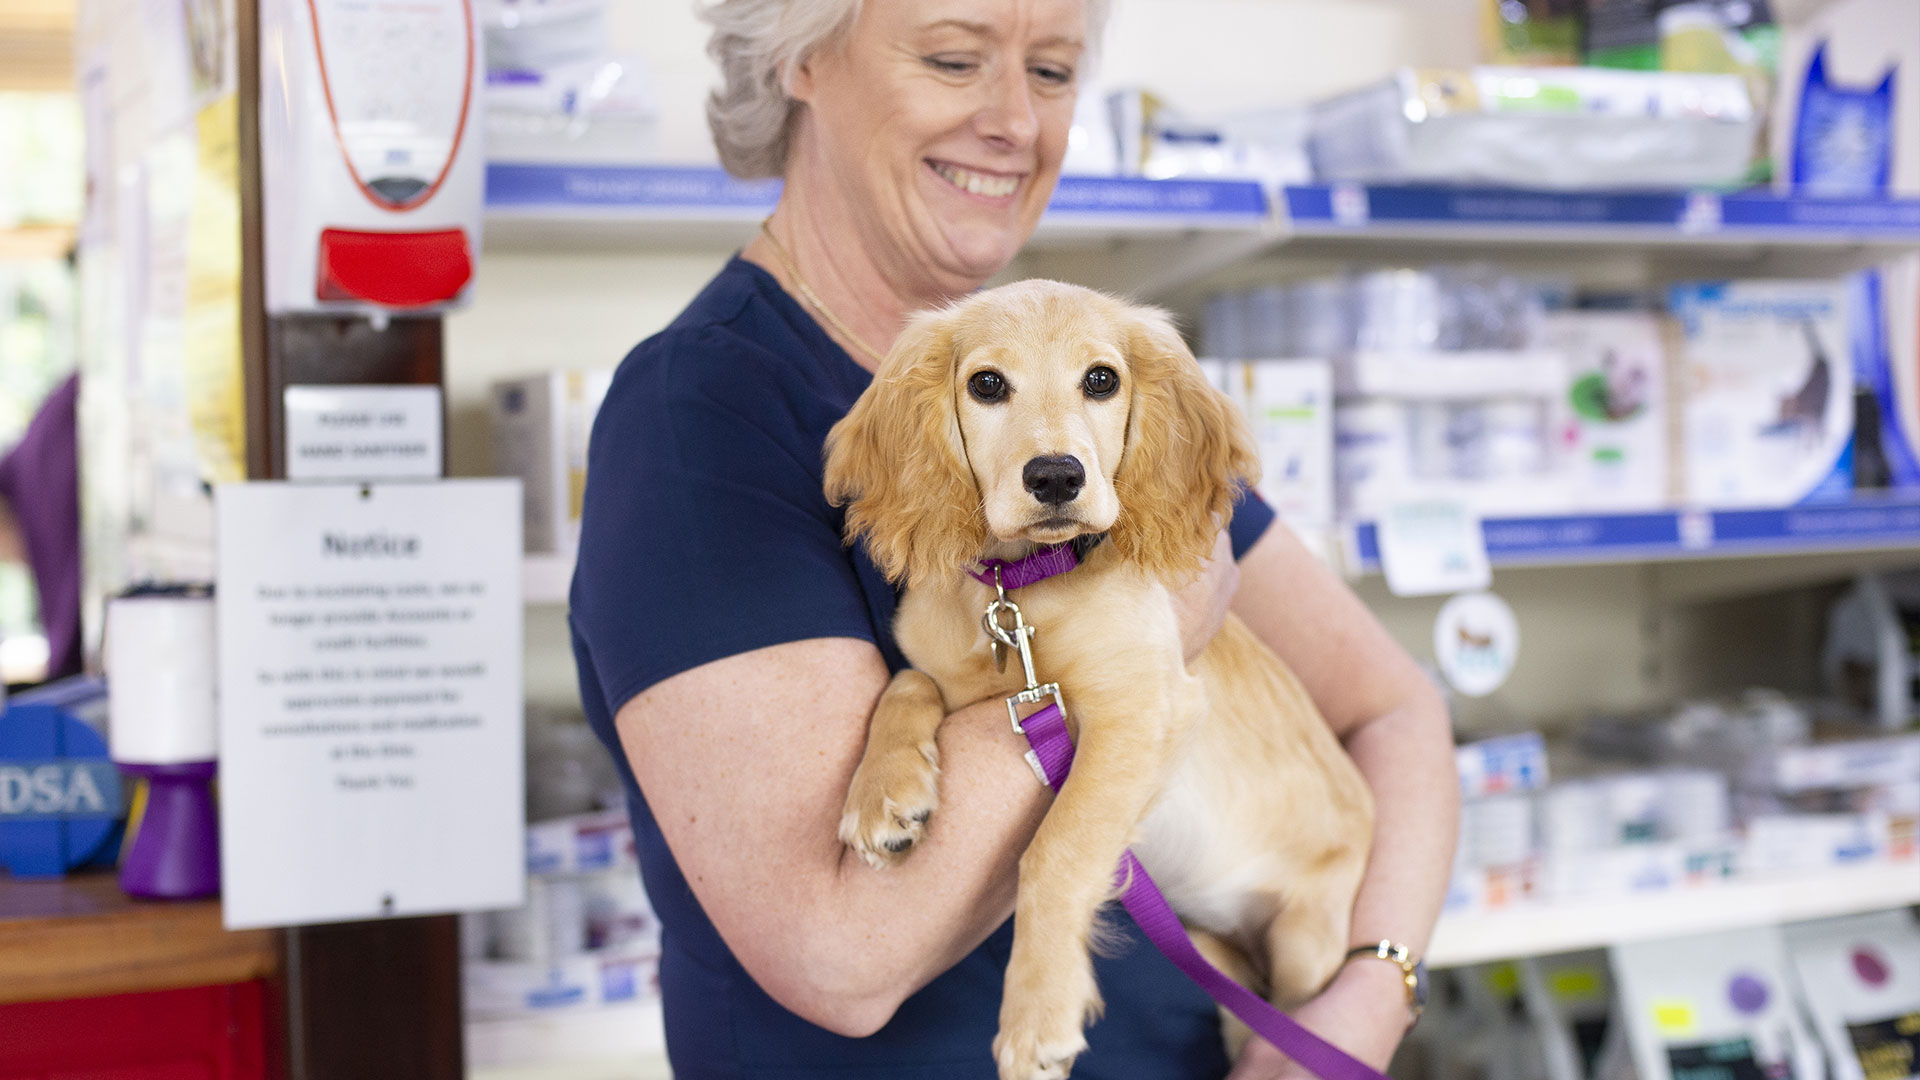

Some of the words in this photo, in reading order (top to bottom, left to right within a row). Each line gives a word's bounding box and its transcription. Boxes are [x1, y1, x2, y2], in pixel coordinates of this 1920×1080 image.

[318, 412, 372, 427] PLEASE
[378, 412, 407, 427] USE
[299, 443, 345, 458] HAND
[322, 531, 419, 557] Notice
[0, 764, 104, 813] DSA
